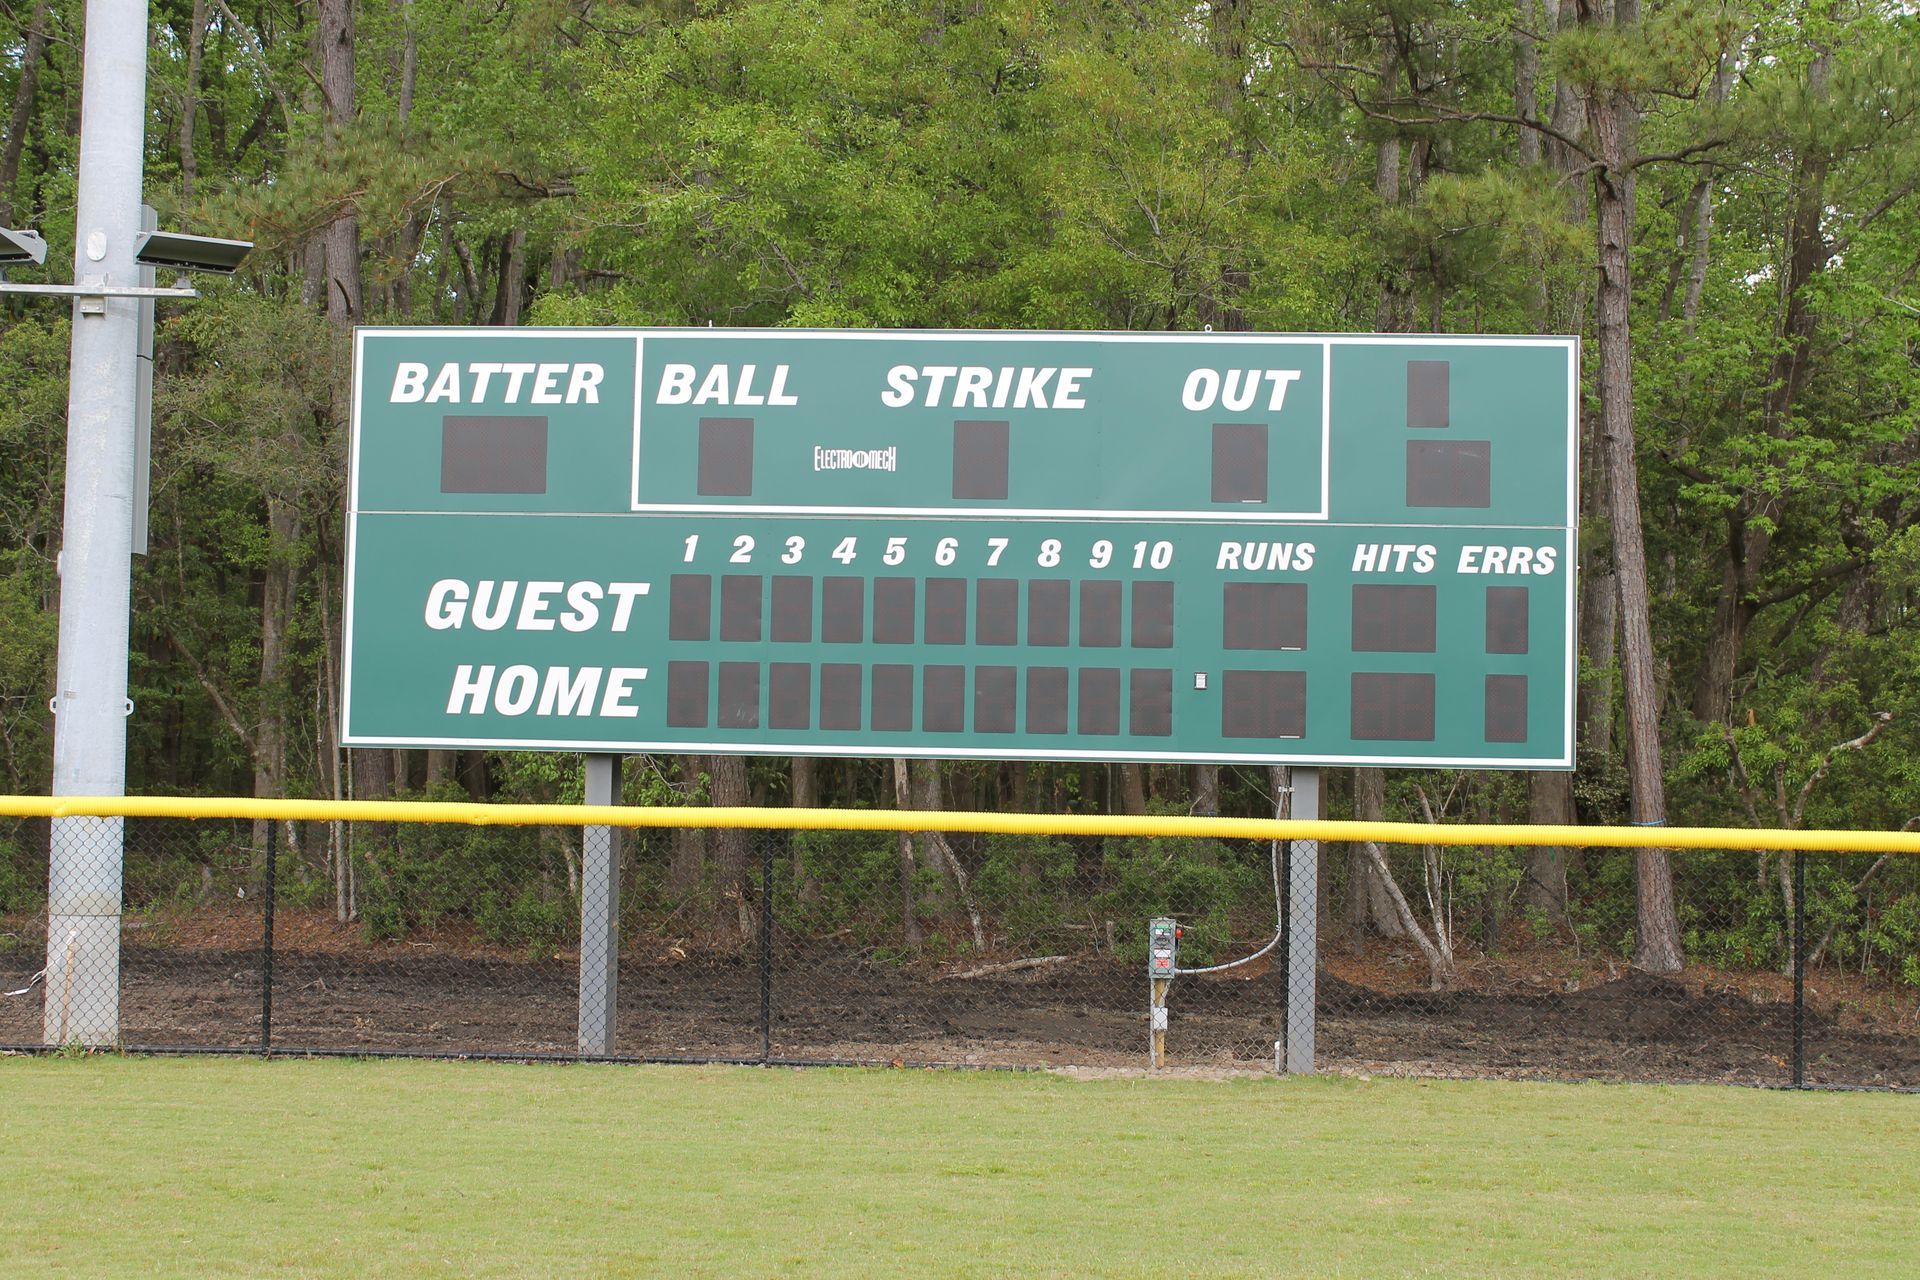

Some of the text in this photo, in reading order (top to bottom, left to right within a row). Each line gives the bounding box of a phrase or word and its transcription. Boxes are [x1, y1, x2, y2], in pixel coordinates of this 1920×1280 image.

[389, 361, 605, 405] BATTER
[656, 363, 799, 406] BALL
[881, 364, 1094, 410] STRIKE
[1182, 367, 1302, 412] OUT
[684, 534, 1558, 576] 1 2 3 4 5 6 7 8 9 10 RUNS HITS ERRS
[424, 579, 651, 632] GUEST
[446, 664, 649, 718] HOME
